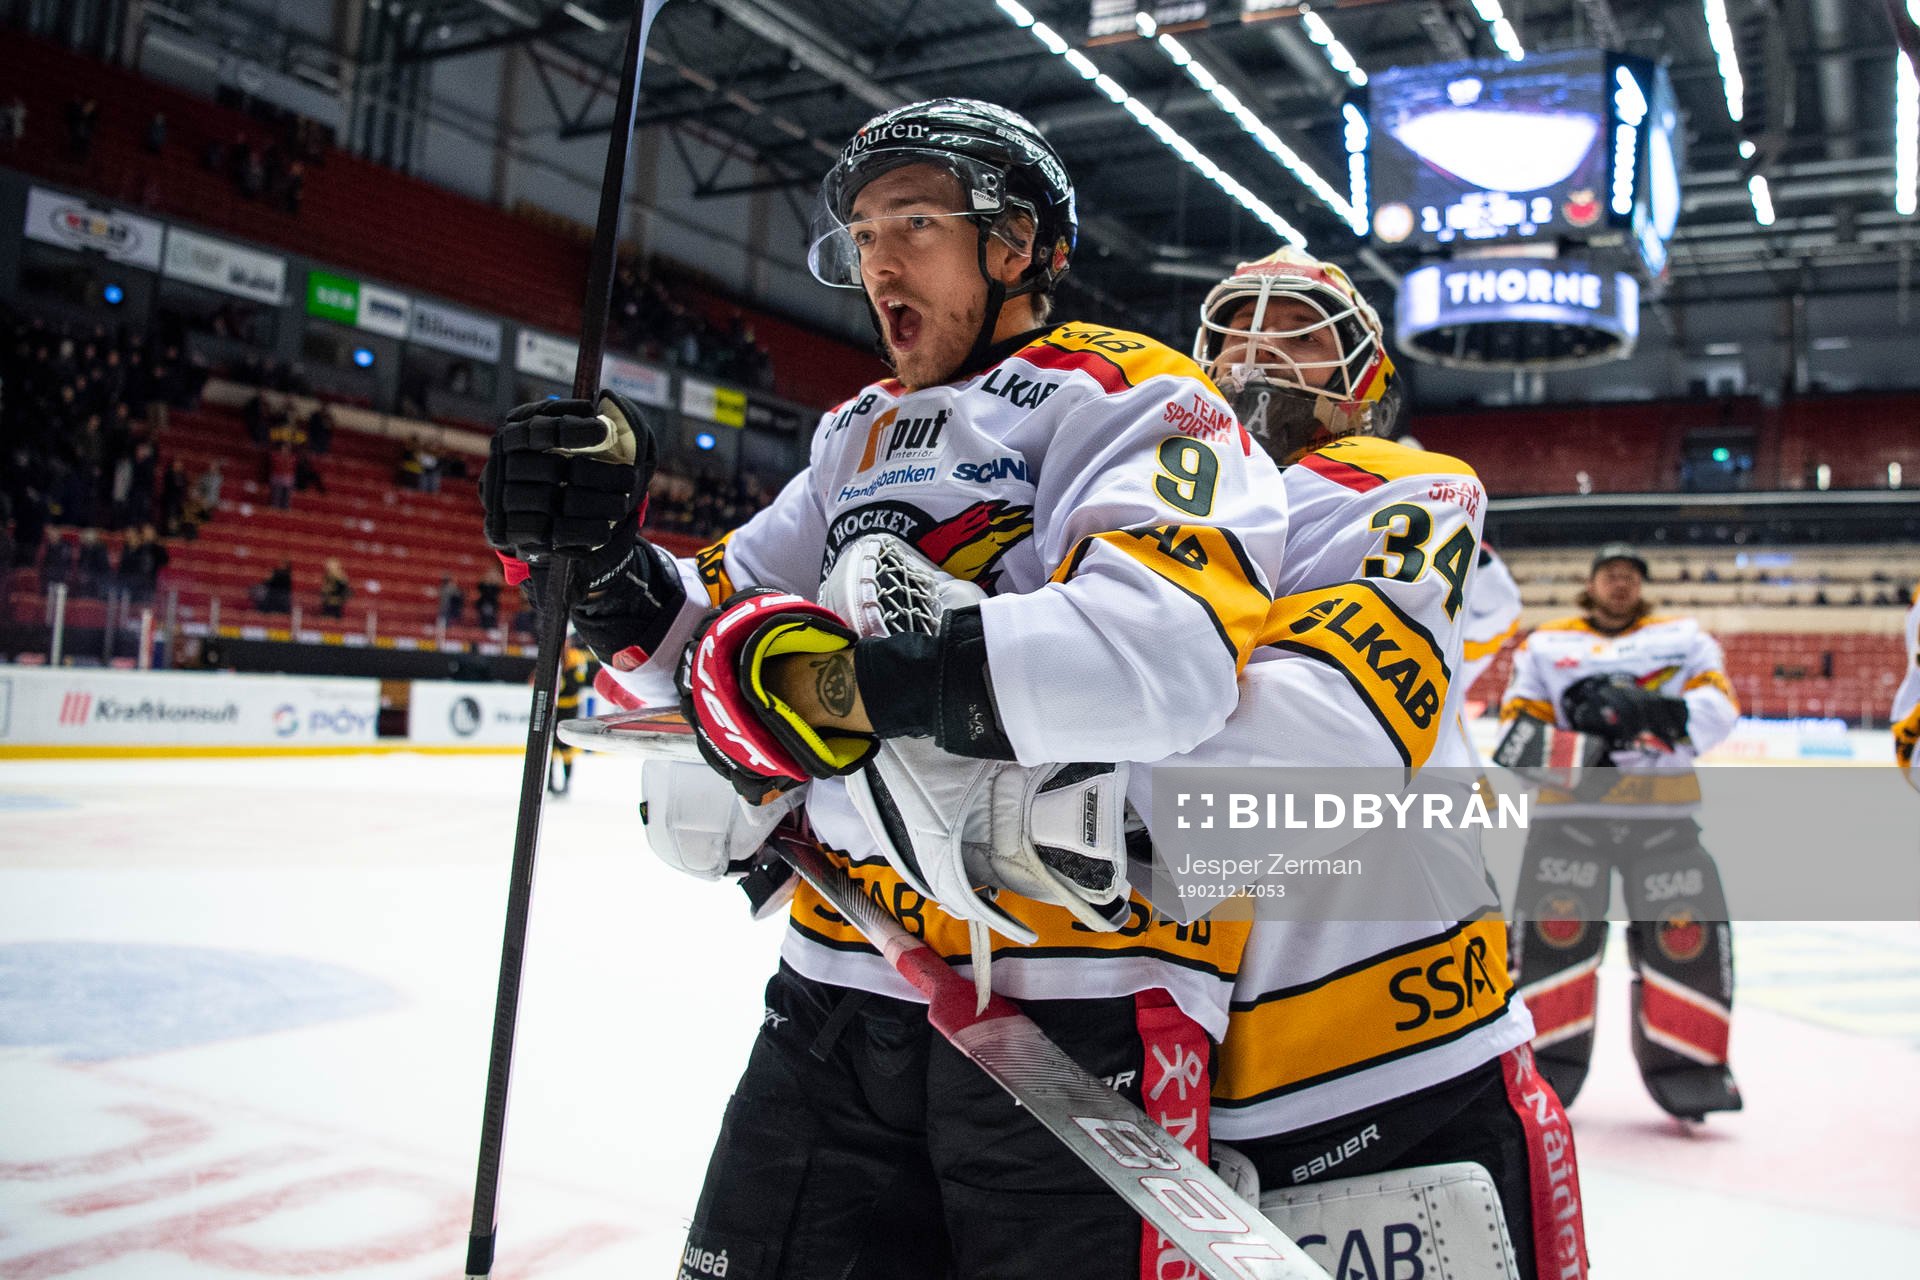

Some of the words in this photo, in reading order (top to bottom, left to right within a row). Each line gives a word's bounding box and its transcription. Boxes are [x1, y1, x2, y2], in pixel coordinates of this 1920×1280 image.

[1445, 268, 1601, 308] THORNE
[1164, 402, 1230, 445] SPORTIA
[1193, 393, 1232, 433] TEAM
[837, 464, 936, 502] Handsbanken
[952, 457, 1030, 483] SCAN
[1152, 435, 1221, 517] 9
[833, 509, 918, 546] HOCKEY
[1362, 502, 1476, 623] 34
[1325, 600, 1440, 730] LKAB
[1536, 857, 1599, 888] SSAB
[1644, 869, 1704, 902] SSAB
